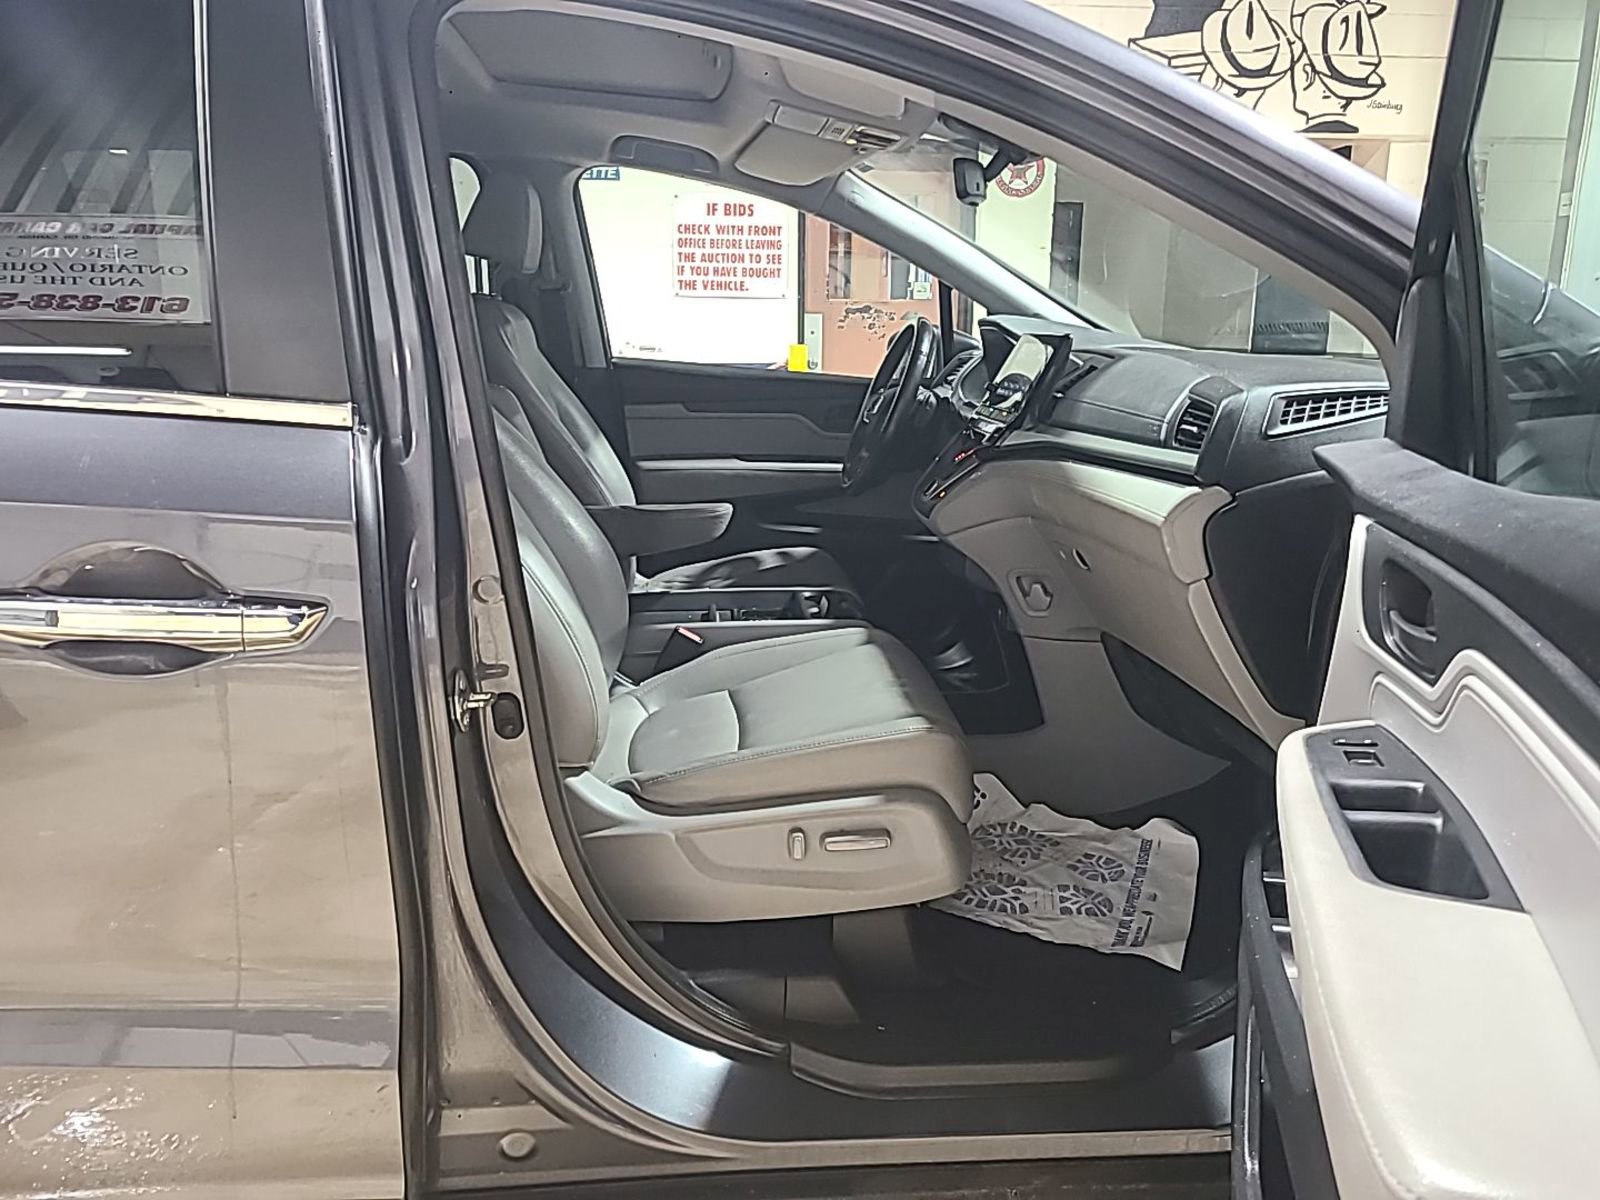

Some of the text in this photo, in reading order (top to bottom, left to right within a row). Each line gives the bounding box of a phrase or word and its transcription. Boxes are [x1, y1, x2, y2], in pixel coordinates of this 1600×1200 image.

[706, 202, 754, 217] IF BIDS
[677, 224, 782, 236] CHECK WITH FRONT
[677, 238, 782, 250] OFFICE BEFORE LEAVING
[677, 252, 782, 265] THE AUCTION TO SEE
[677, 265, 782, 278] IF YOU HAVE BOUGHT
[677, 279, 749, 291] THE VEHICLE.
